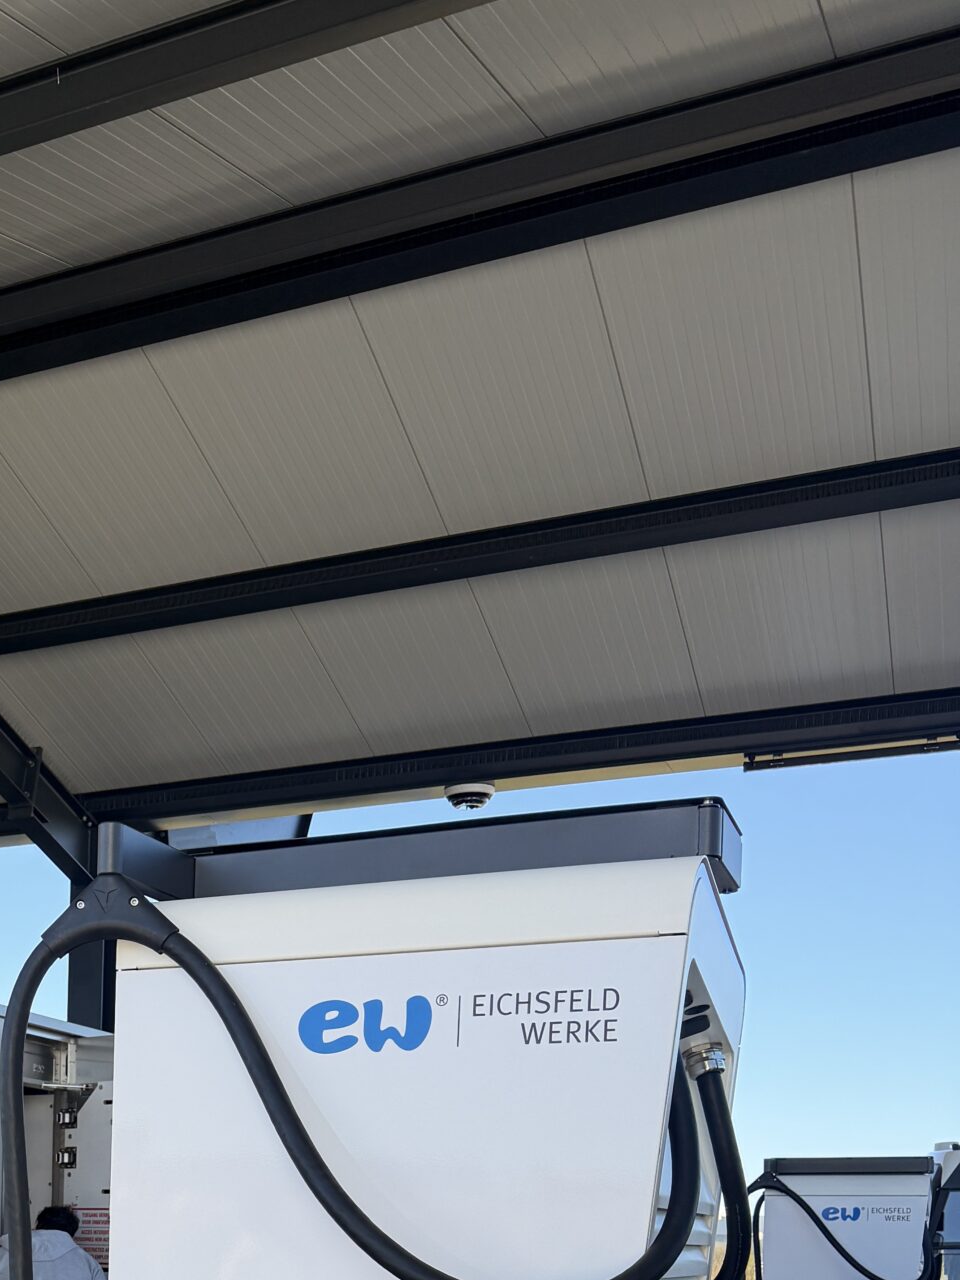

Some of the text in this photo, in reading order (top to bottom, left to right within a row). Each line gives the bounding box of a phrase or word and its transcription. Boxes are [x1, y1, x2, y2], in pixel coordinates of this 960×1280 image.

[472, 988, 620, 1017] EICHSFELD
[520, 1019, 619, 1045] WERKE
[884, 1214, 911, 1222] WERKE
